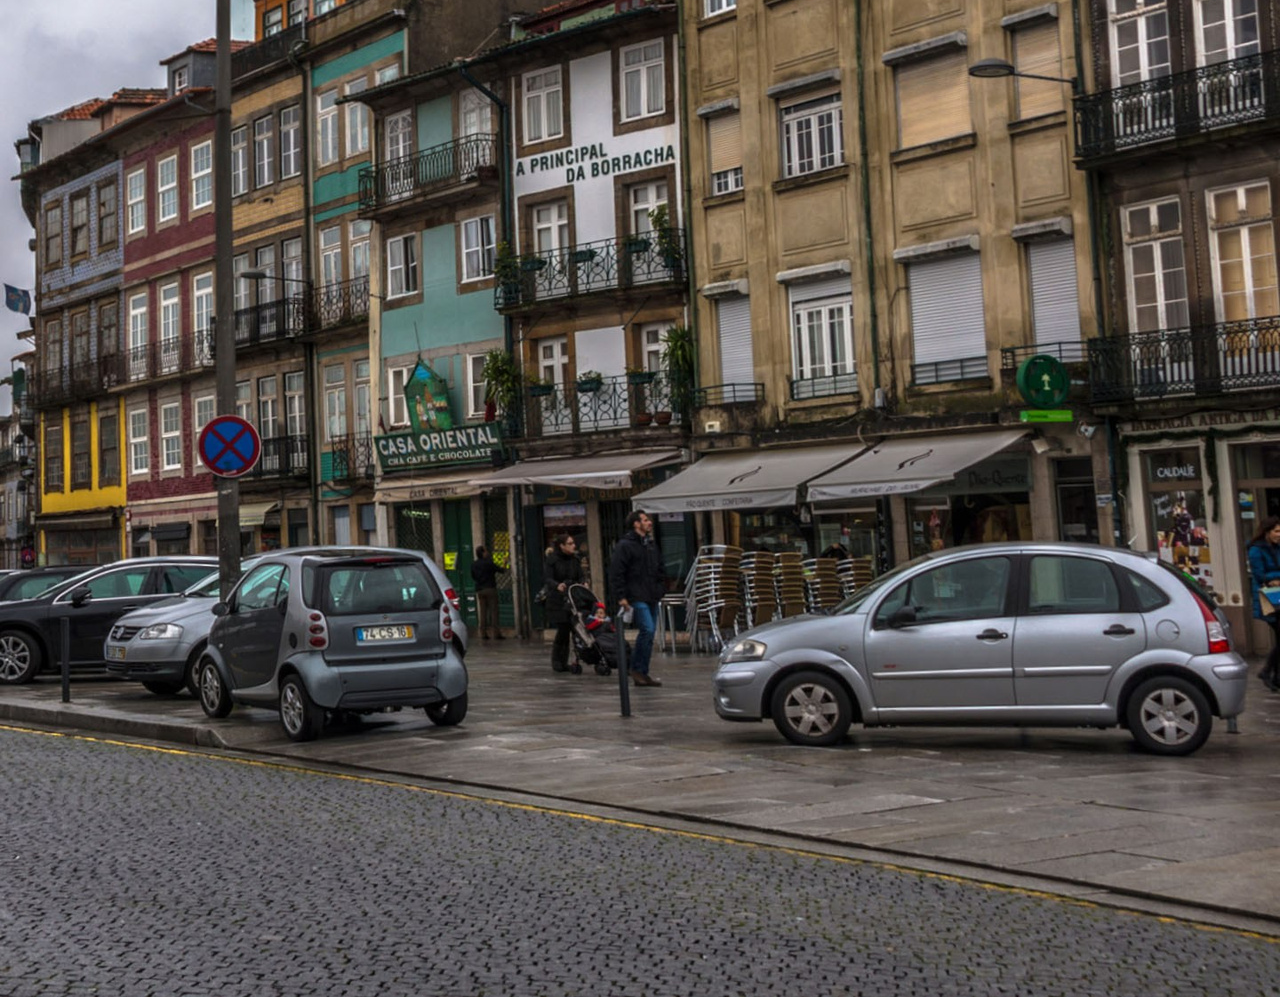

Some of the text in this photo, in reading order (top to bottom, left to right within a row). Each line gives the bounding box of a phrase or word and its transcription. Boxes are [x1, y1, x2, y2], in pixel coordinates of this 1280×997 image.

[516, 143, 608, 177] A PRINCIPAL
[566, 145, 675, 183] DA BORRACHA
[379, 426, 498, 456] CASA ORIENTAL
[430, 452, 436, 461] E
[438, 448, 492, 461] CHOCOLATE
